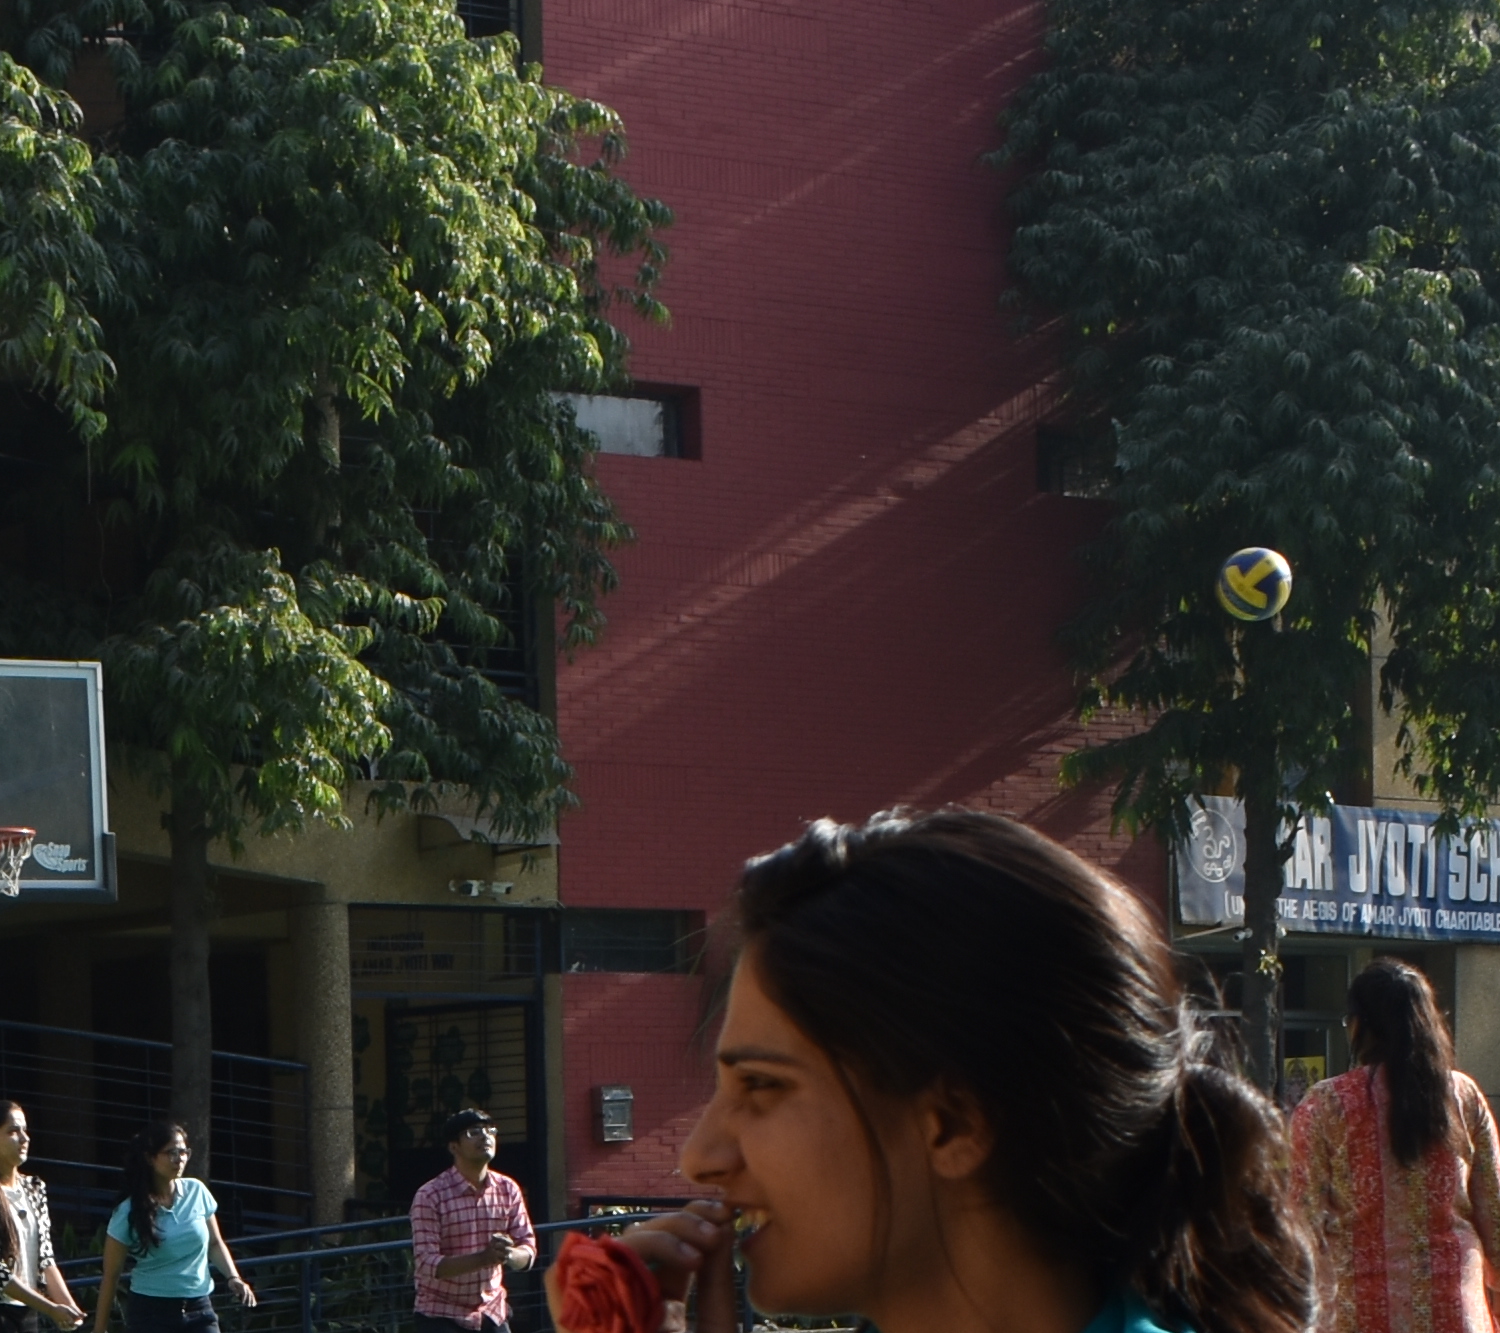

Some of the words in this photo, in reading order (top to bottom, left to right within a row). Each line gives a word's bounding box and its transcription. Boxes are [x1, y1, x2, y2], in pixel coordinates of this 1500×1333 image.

[48, 841, 71, 859] Snap
[1348, 818, 1437, 899] JYOTI
[1275, 897, 1299, 920] THE
[1302, 898, 1337, 922] AEGIS
[1342, 901, 1357, 923] OF
[1360, 903, 1395, 926] AMAR
[1398, 906, 1431, 928] JYOTI
